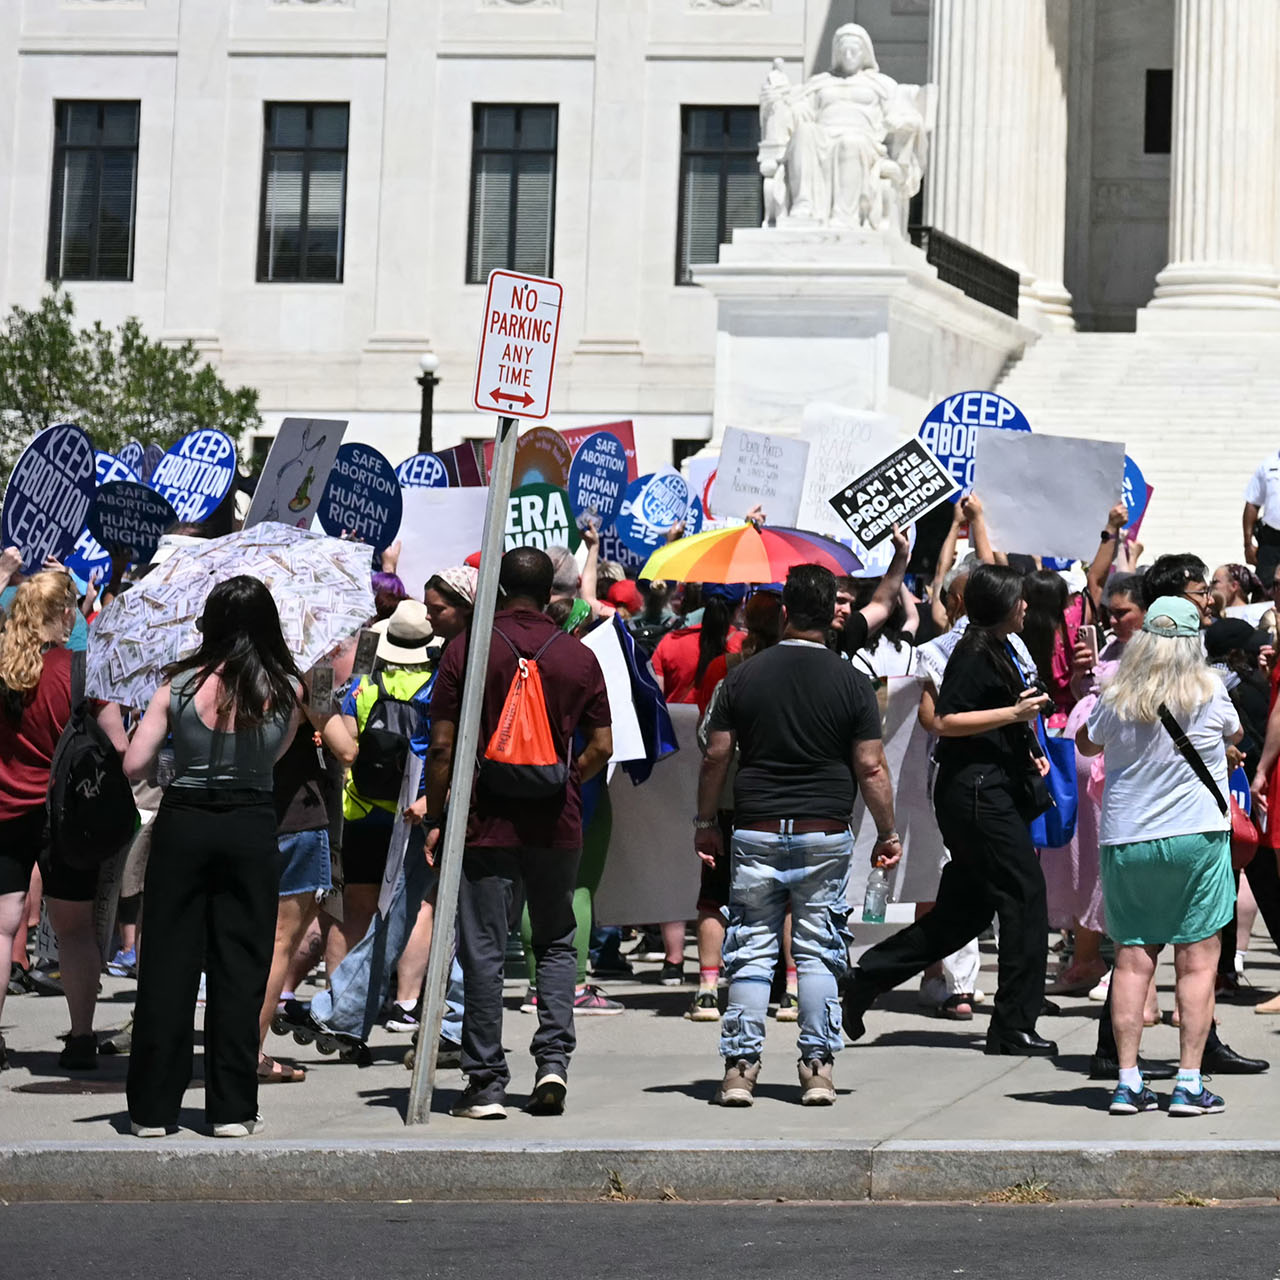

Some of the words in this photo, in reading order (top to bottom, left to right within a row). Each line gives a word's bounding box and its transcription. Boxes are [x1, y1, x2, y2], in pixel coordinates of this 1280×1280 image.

[511, 285, 538, 313] NO
[490, 310, 553, 344] PARKING
[502, 343, 534, 365] ANY
[498, 364, 533, 388] TIME
[942, 392, 1016, 427] KEEP
[44, 428, 94, 483] KEEP
[179, 430, 231, 464] KEEP
[351, 449, 383, 471] SAFE
[581, 448, 625, 472] ABORTION
[595, 438, 617, 455] SAFE
[152, 452, 233, 500] ABORTION
[333, 458, 396, 497] ABORTION
[398, 458, 444, 486] KEEP
[578, 473, 619, 498] HUMAN
[665, 476, 688, 498] KEEP
[841, 503, 852, 515] I
[856, 480, 884, 506] AM
[885, 452, 922, 481] THE
[13, 448, 91, 538] ABORTION
[97, 492, 168, 516] ABORTION
[116, 485, 149, 501] SAFE
[329, 483, 389, 524] HUMAN
[353, 482, 362, 492] IS
[362, 487, 369, 497] A
[578, 490, 614, 514] RIGHT!
[846, 459, 939, 532] PRO-LIFE
[100, 513, 165, 535] HUMAN
[329, 502, 383, 541] RIGHT!
[505, 491, 569, 533] ERA
[860, 475, 946, 542] GENERATION
[7, 492, 63, 566] LEGAL
